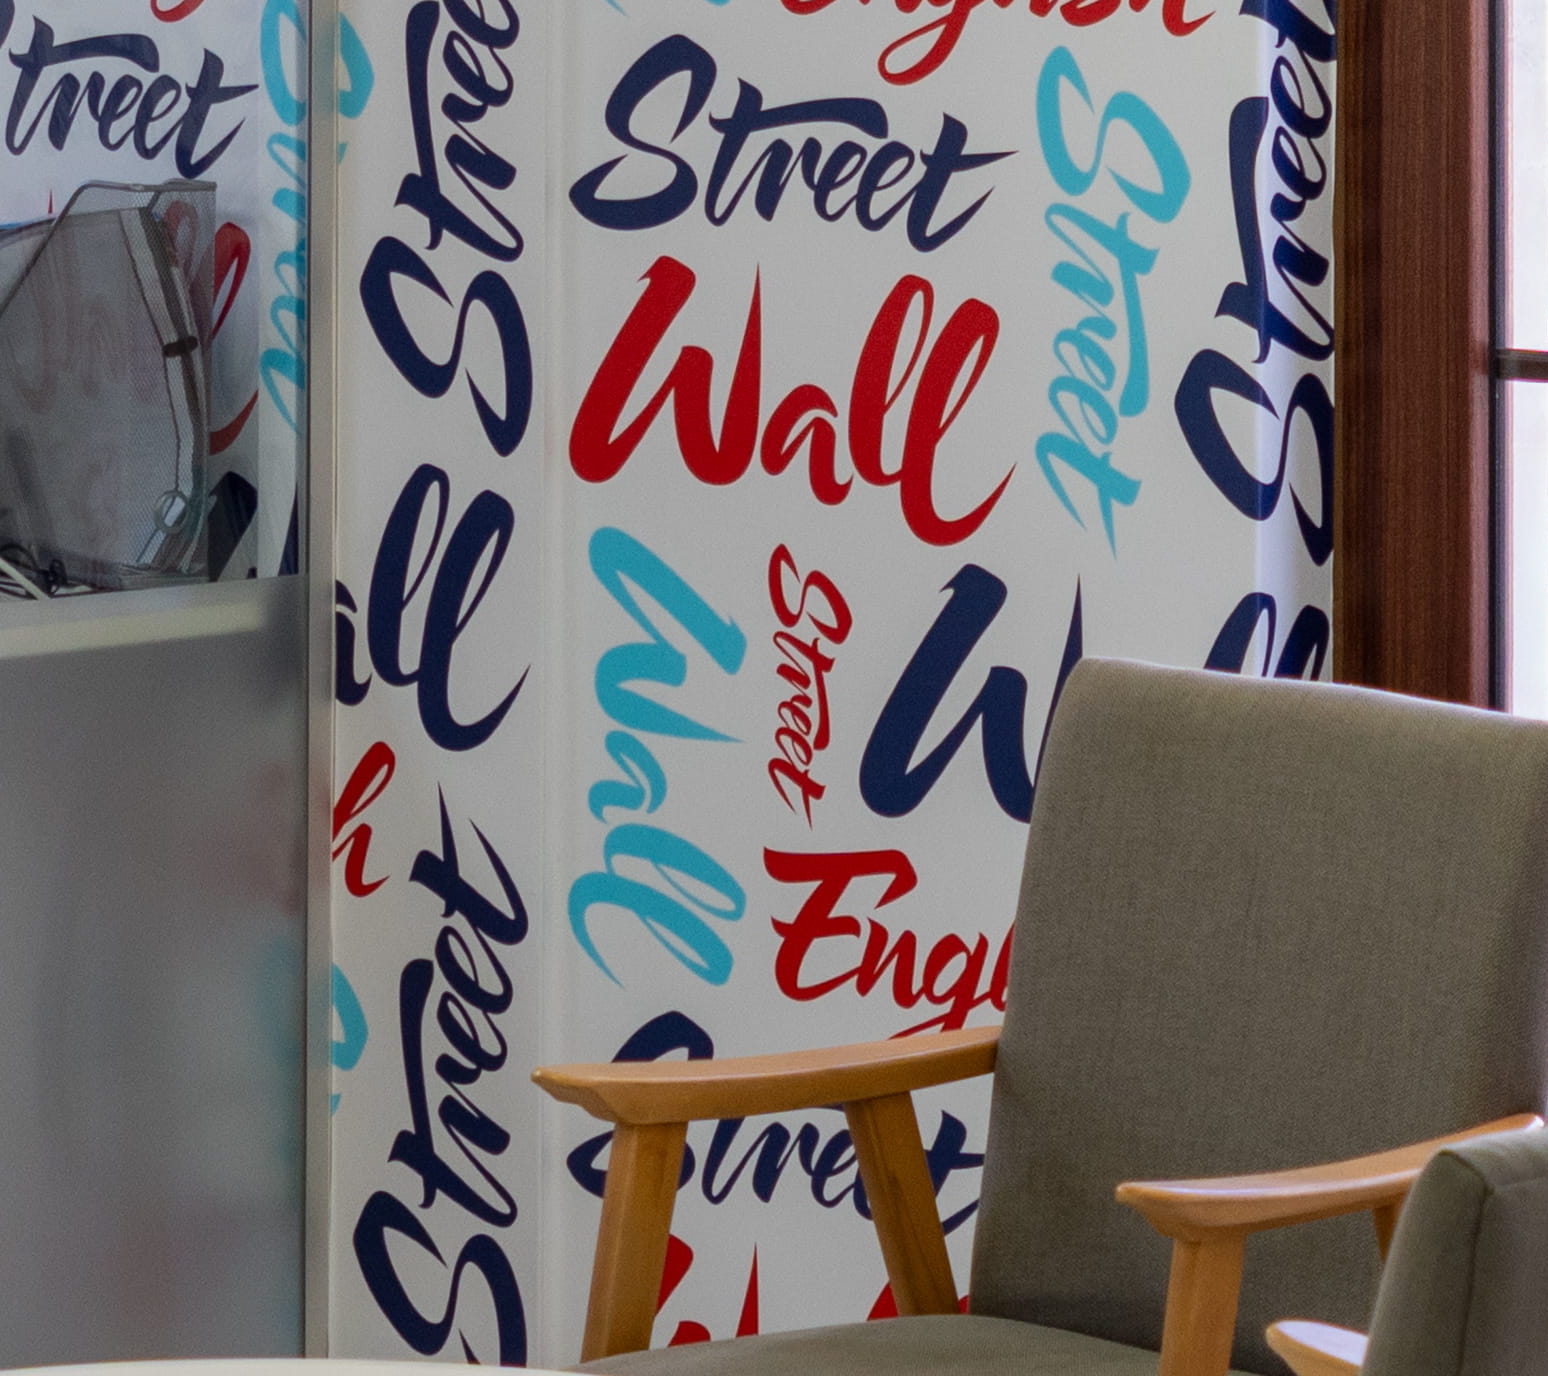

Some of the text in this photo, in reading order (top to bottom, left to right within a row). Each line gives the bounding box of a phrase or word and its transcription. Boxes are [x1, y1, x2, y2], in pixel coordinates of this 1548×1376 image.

[568, 33, 1019, 253] Street
[1035, 45, 1192, 559] Street
[567, 255, 1018, 546] Wall
[566, 526, 747, 989] Wall
[766, 543, 853, 829] Street
[353, 781, 529, 1368] Street
